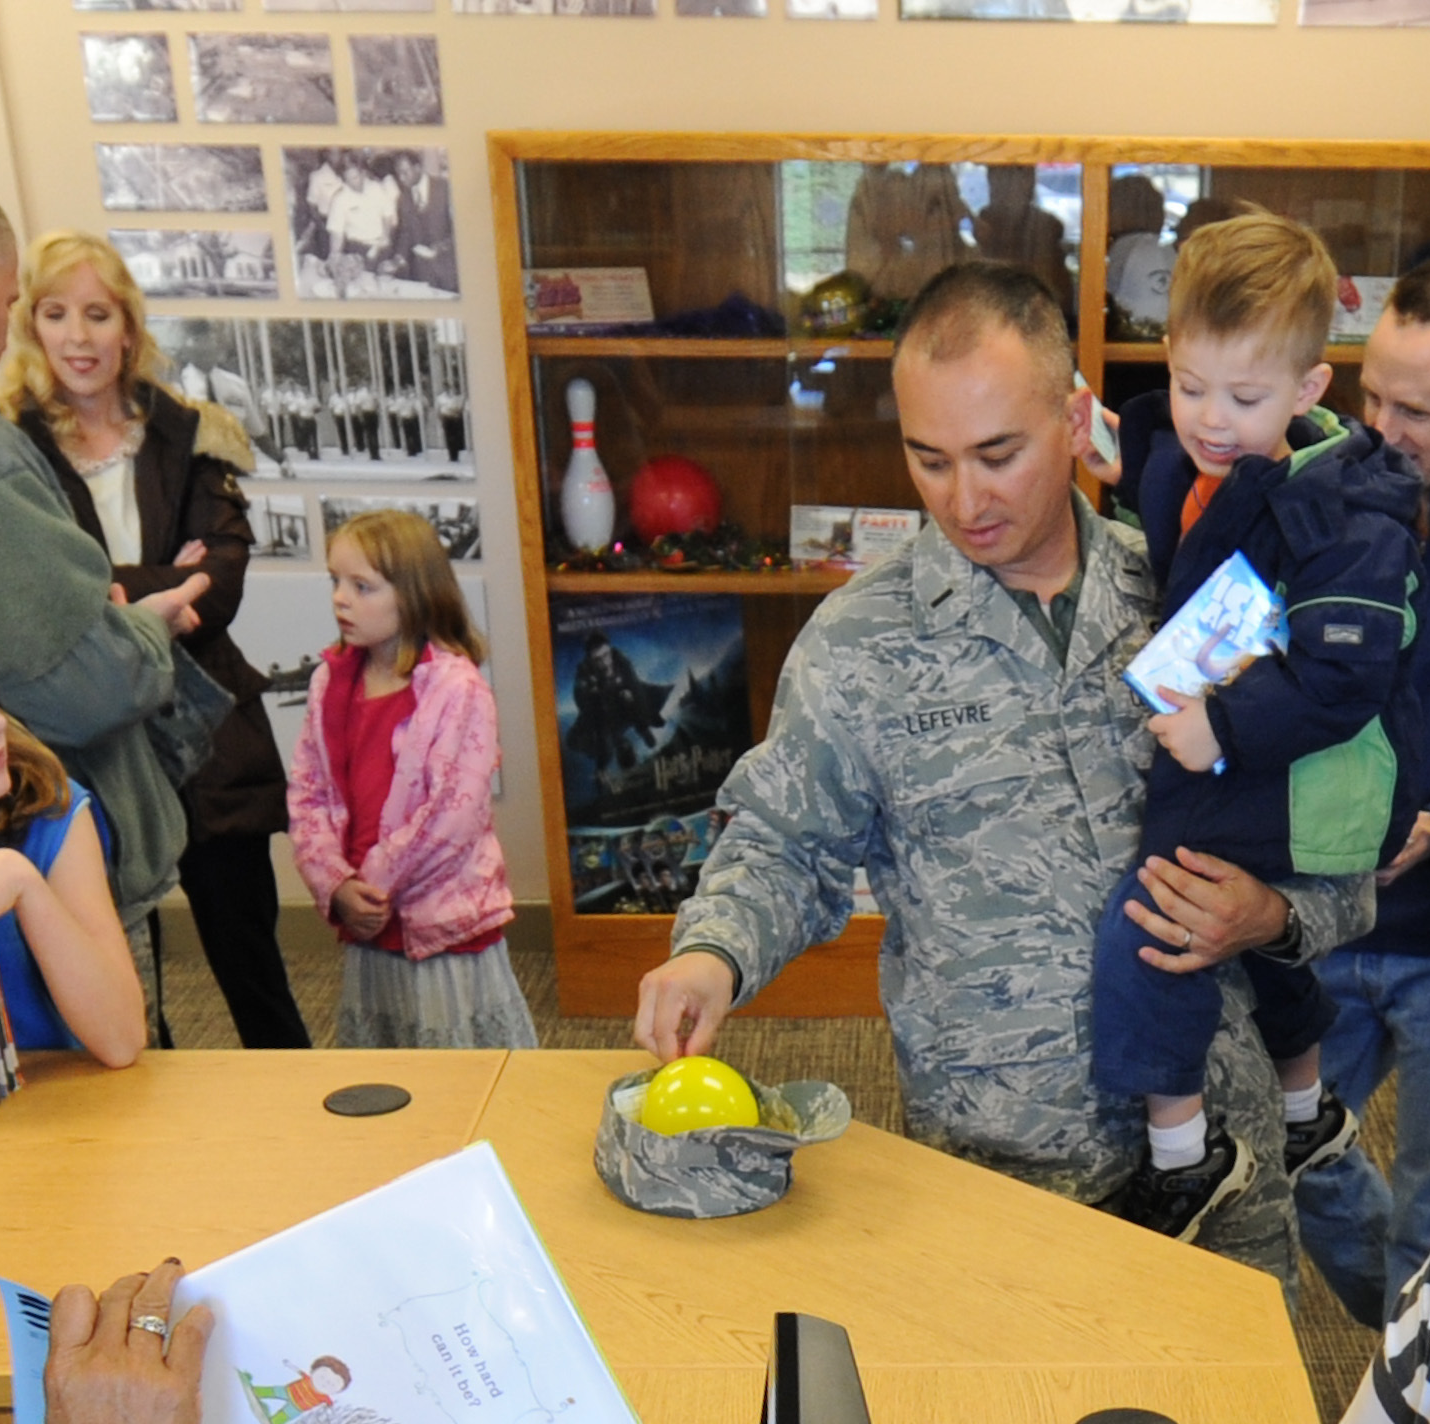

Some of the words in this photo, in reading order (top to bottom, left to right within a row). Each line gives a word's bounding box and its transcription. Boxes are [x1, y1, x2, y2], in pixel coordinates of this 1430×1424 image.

[905, 703, 993, 736] LEFEVRE
[431, 1333, 453, 1363] can
[448, 1363, 463, 1379] it
[457, 1378, 482, 1407] be?
[453, 1322, 479, 1358] How
[474, 1360, 505, 1399] hard
